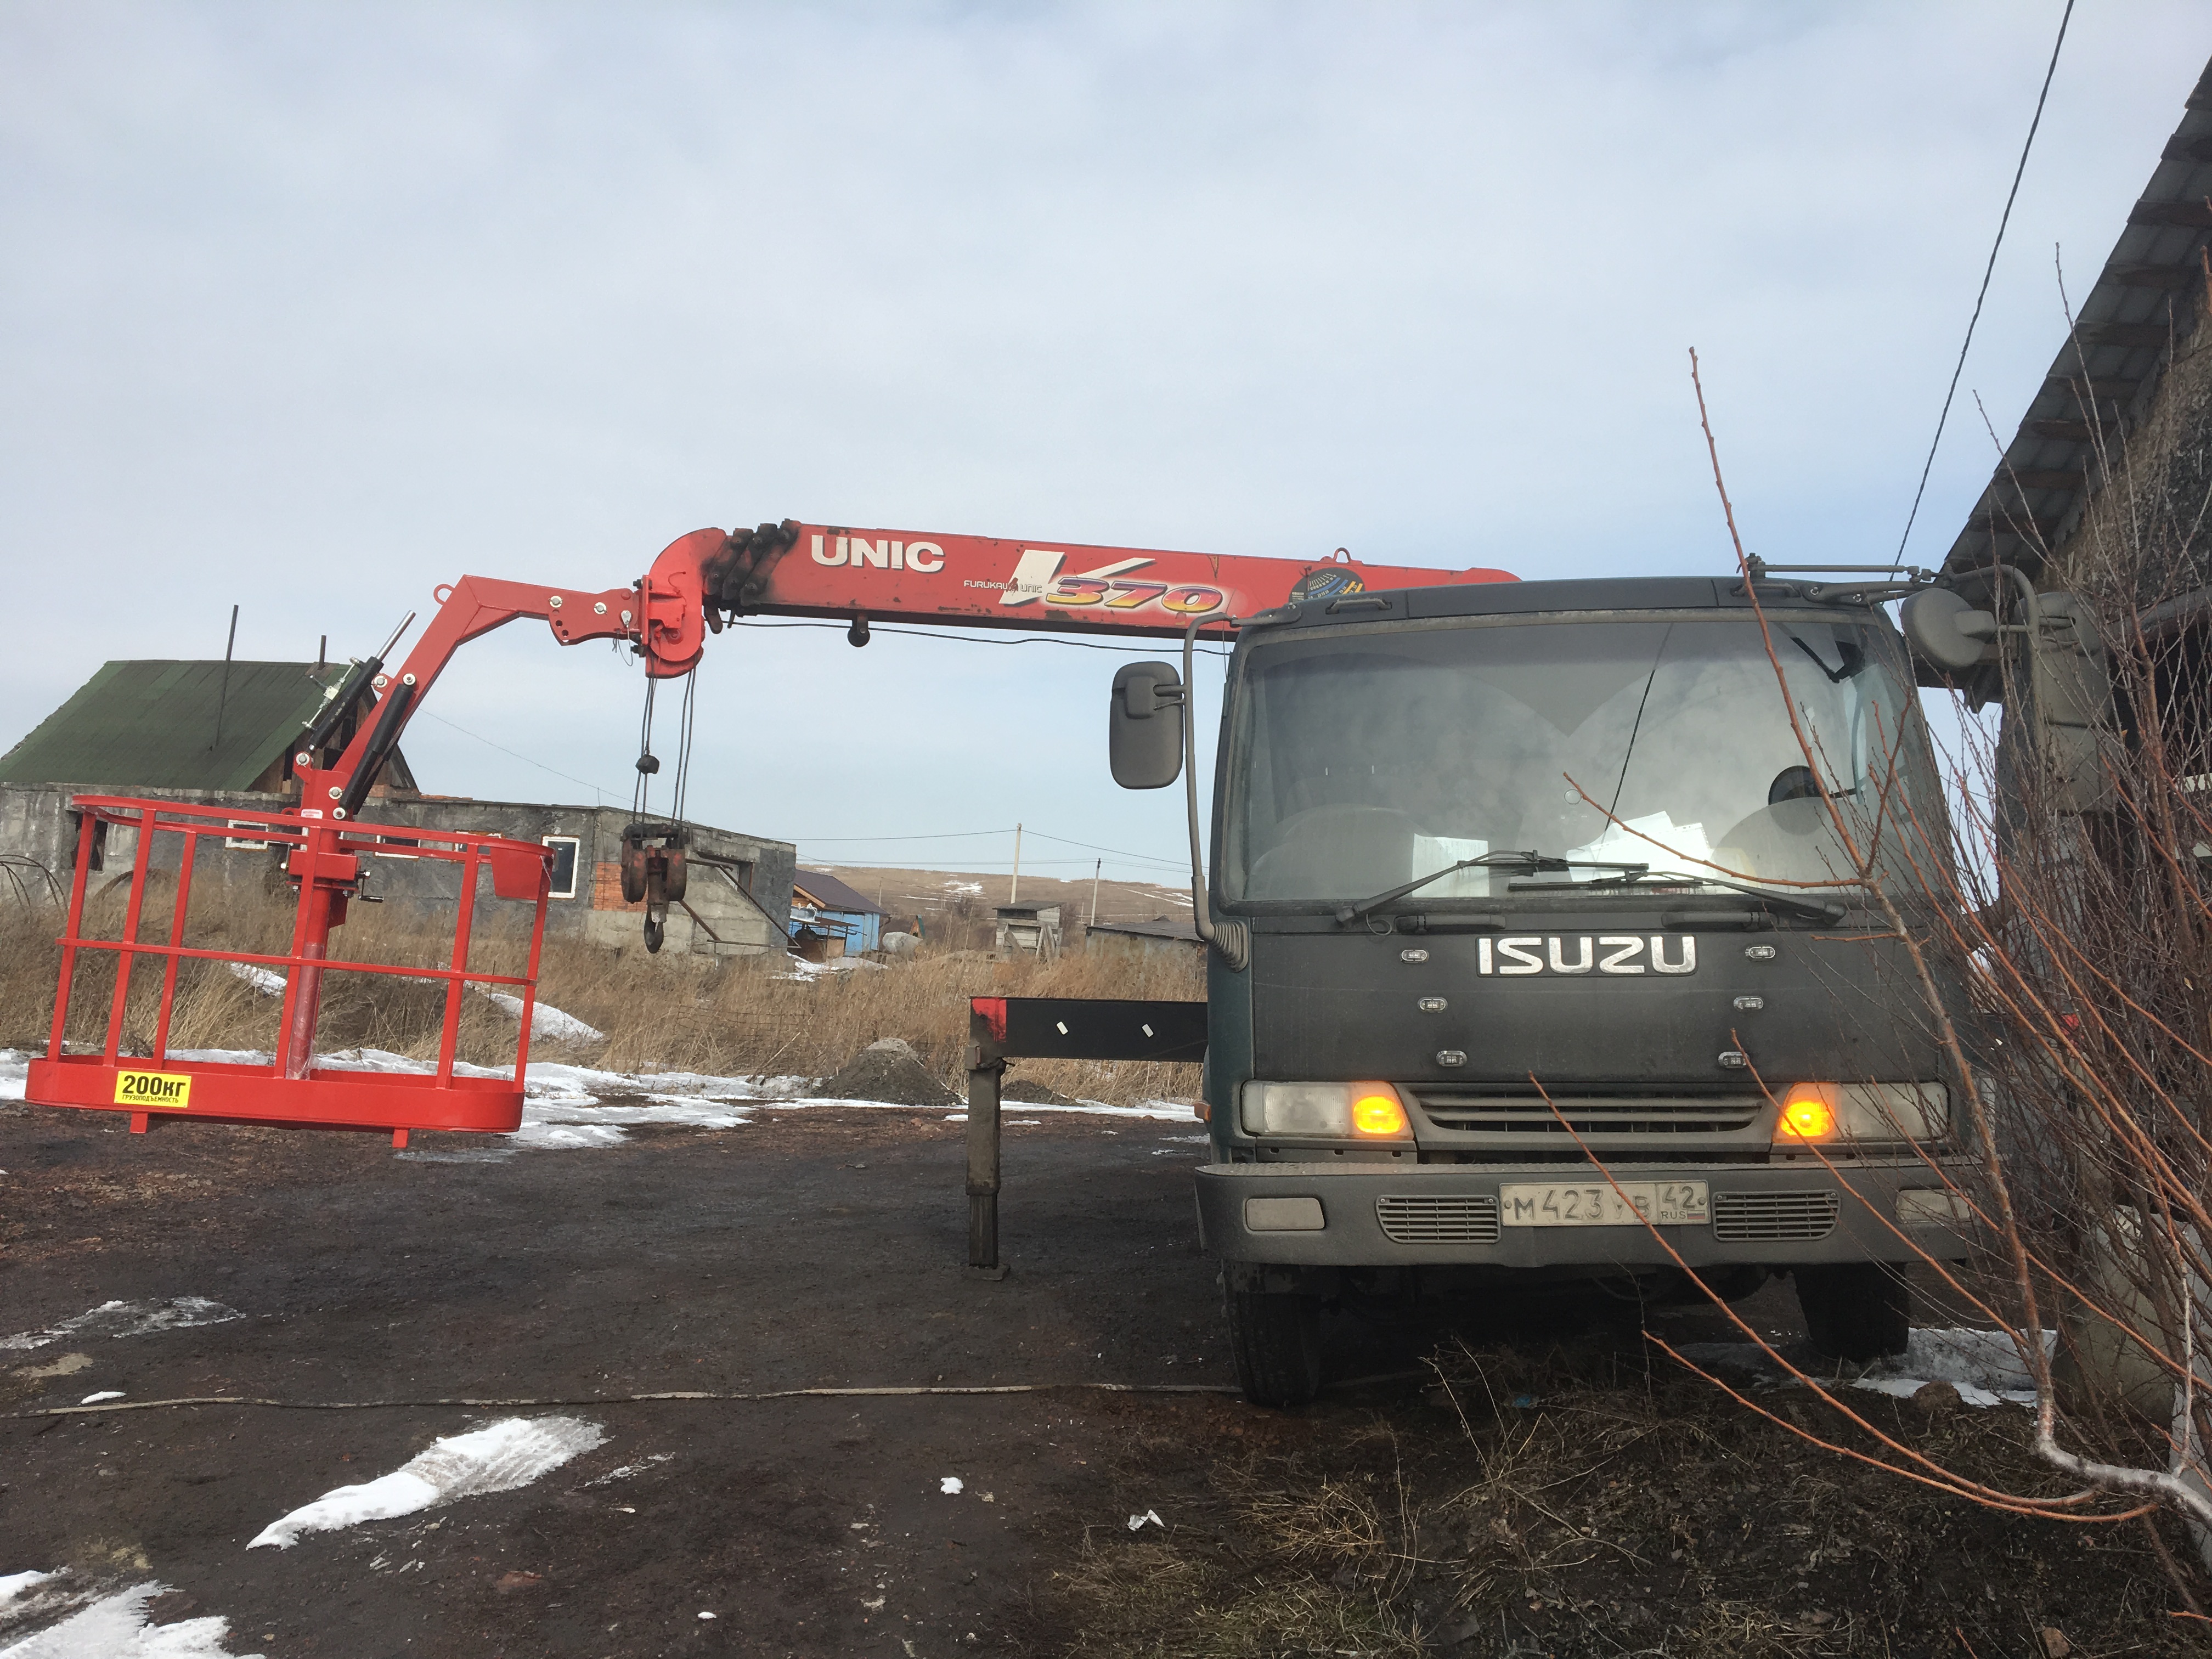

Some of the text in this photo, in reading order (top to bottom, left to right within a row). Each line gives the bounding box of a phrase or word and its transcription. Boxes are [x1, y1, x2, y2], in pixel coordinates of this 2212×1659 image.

[811, 534, 945, 573] UNIC
[964, 580, 1042, 593] FURUKAW UNIC
[1479, 936, 1696, 974] ISUZU
[122, 1094, 179, 1103] ГРУЗОПОДЪЕМНОСТЬ
[1661, 1210, 1686, 1220] RUS
